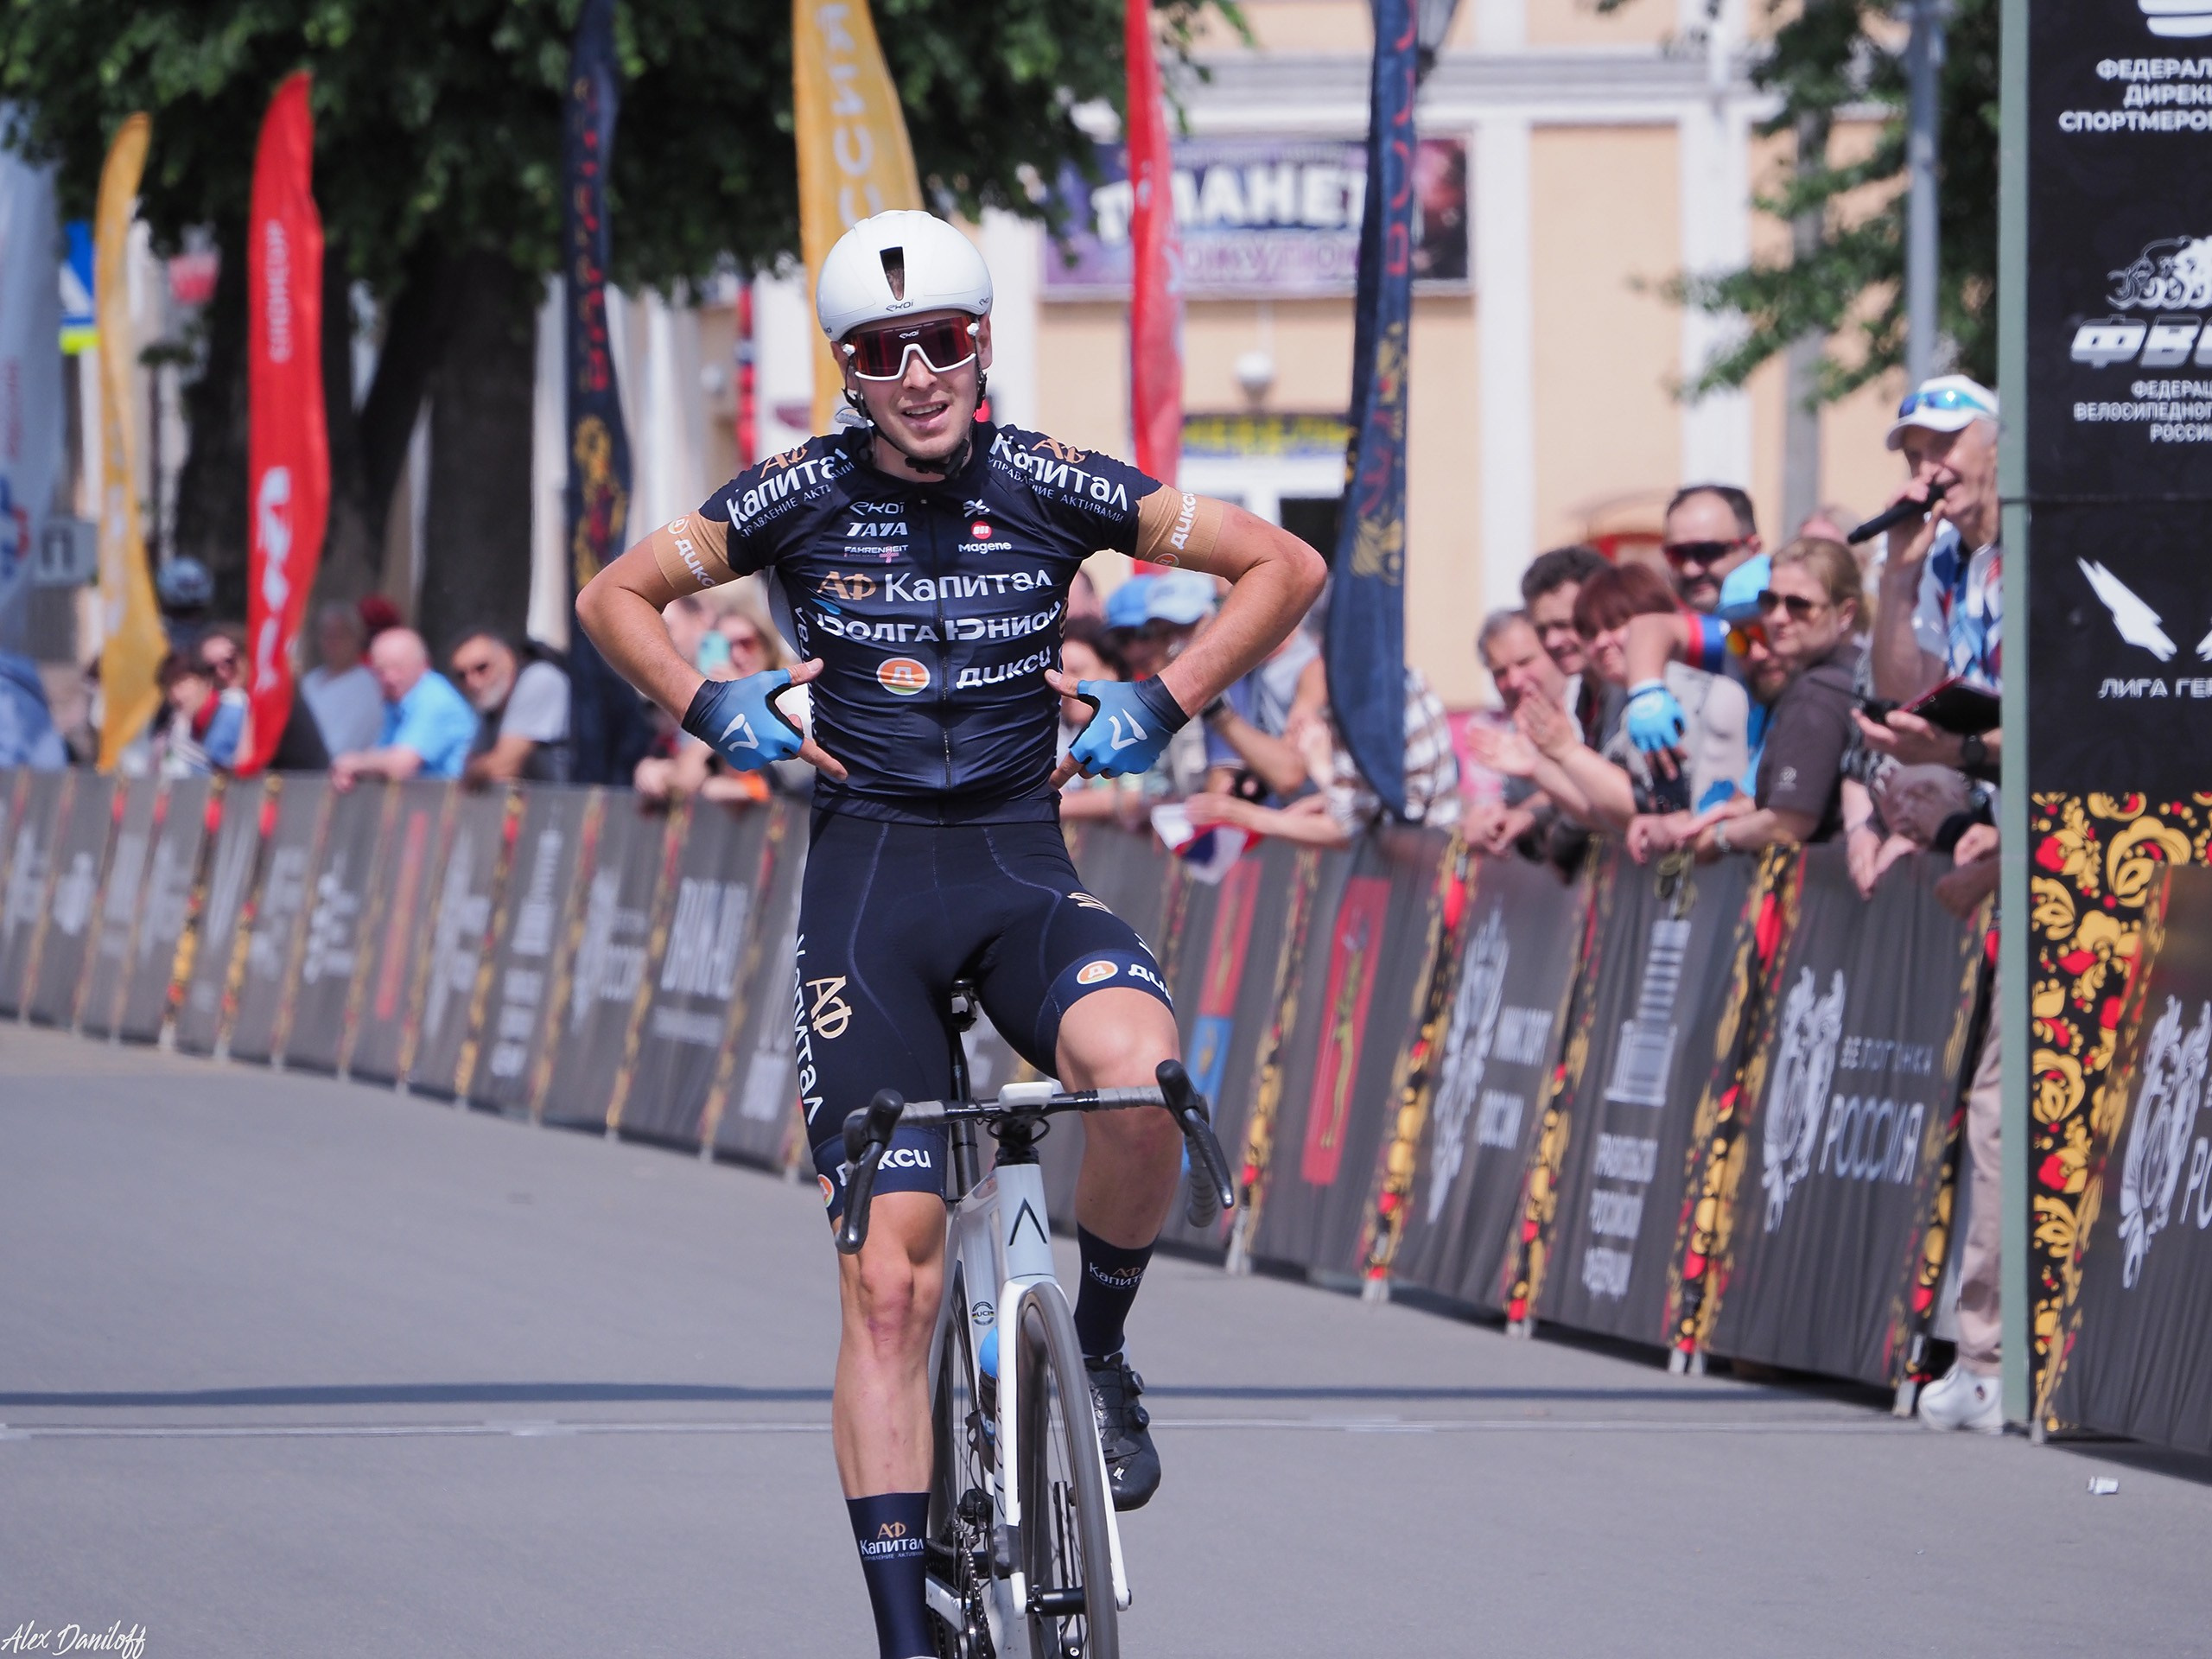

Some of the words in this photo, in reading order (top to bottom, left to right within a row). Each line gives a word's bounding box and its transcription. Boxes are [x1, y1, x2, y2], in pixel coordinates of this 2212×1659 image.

[846, 522, 908, 537] TAYA
[843, 544, 909, 554] FAHRENHEIT
[957, 542, 1012, 555] Magene
[884, 569, 1053, 602] Капитал
[2098, 677, 2168, 699] ЛИГА
[1818, 1092, 1925, 1185] РОССИЯ
[859, 1538, 924, 1554] Капитал
